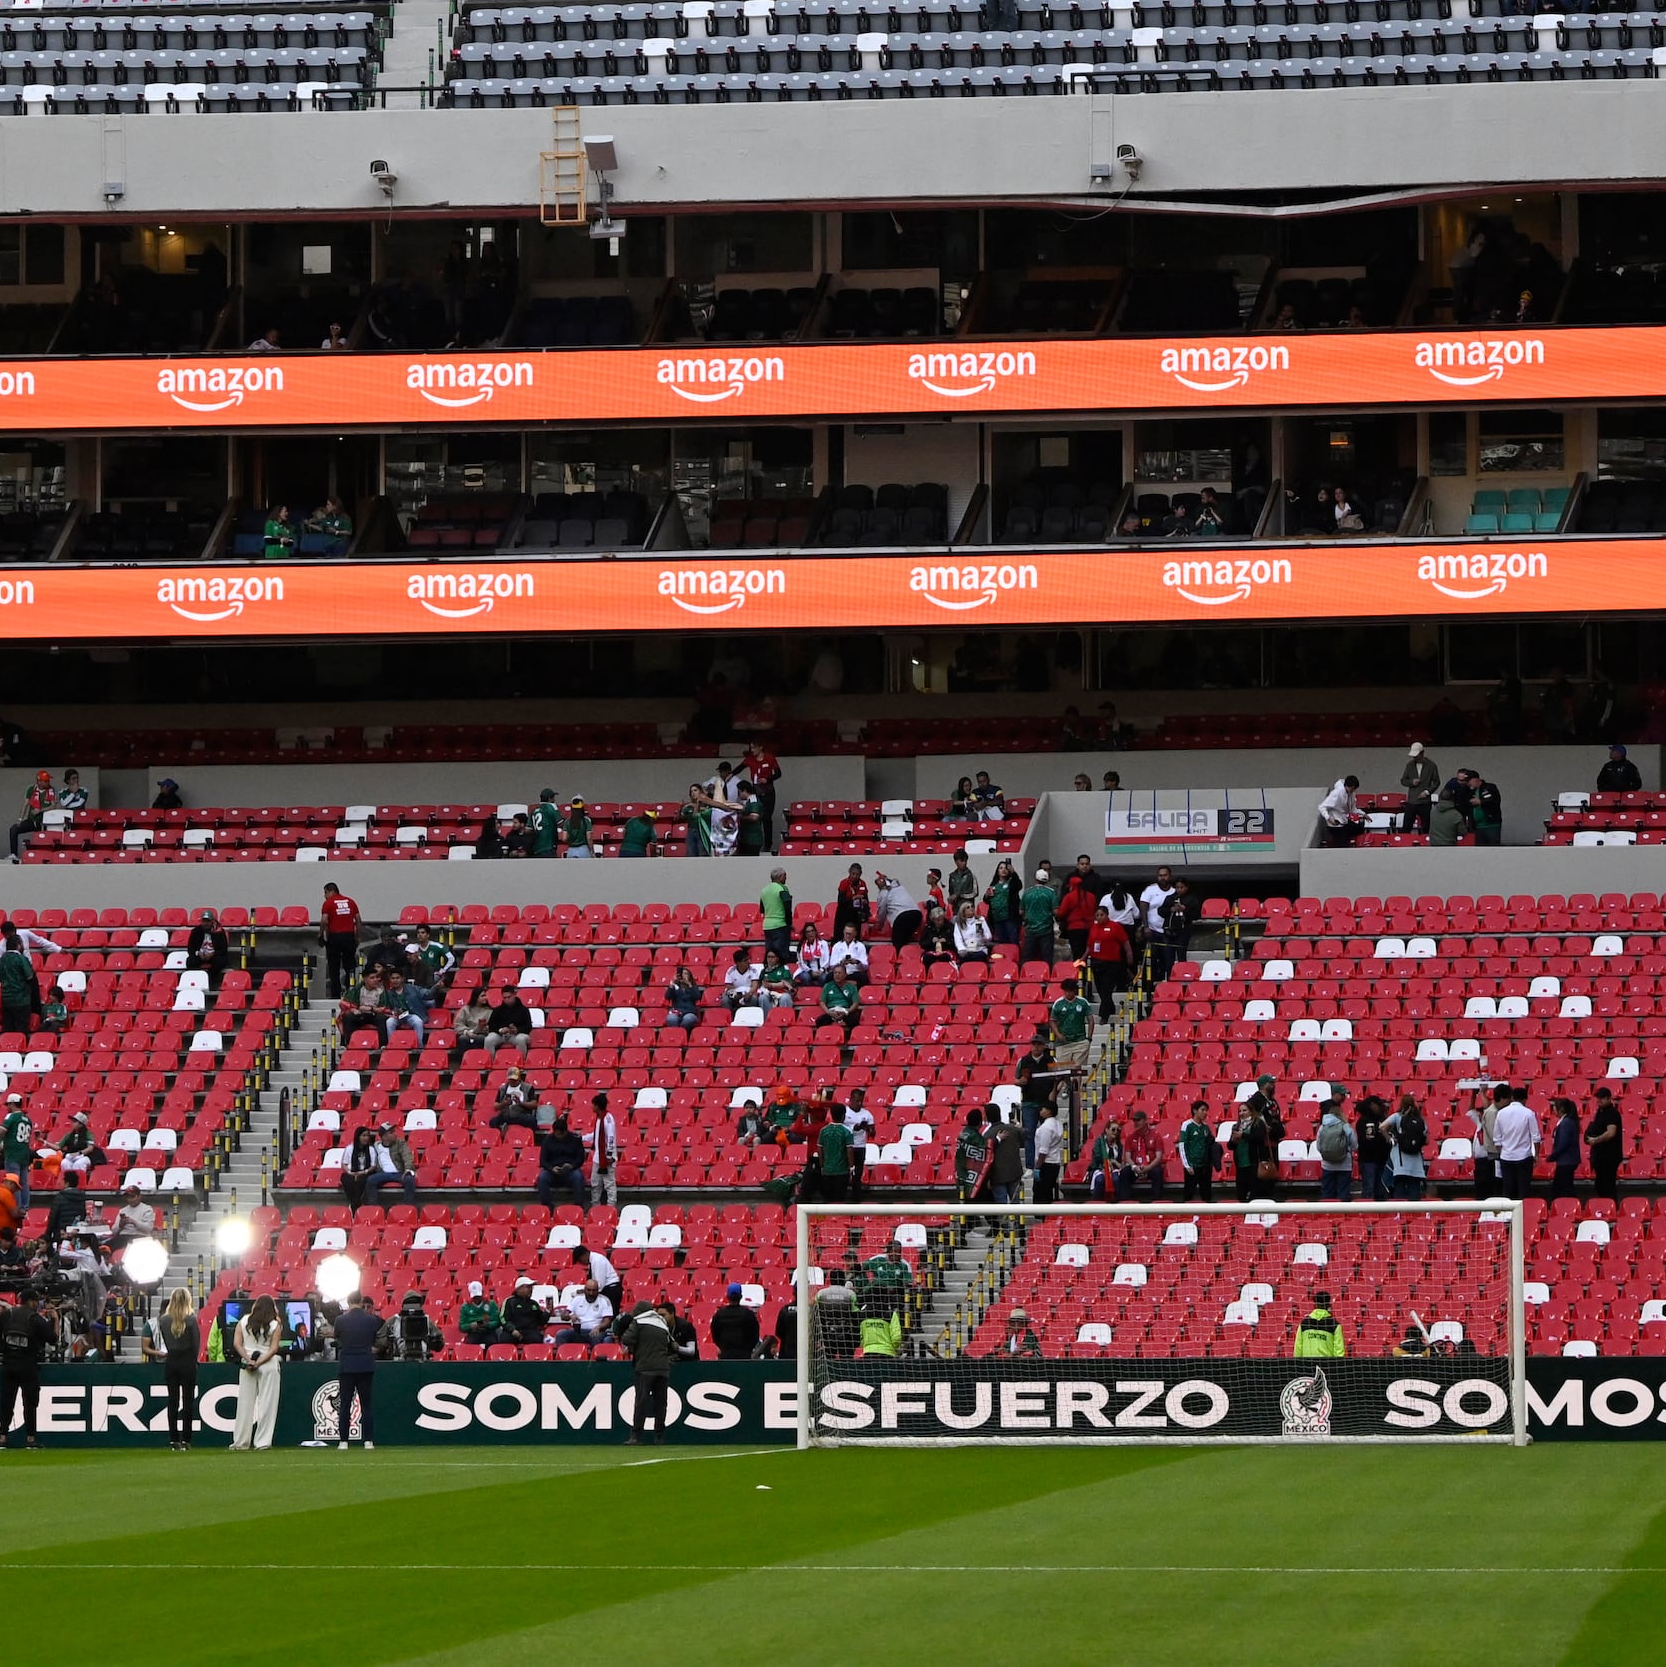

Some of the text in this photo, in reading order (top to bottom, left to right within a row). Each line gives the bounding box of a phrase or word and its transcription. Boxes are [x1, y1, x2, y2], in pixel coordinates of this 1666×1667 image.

[158, 367, 283, 392] amazon
[407, 363, 533, 388] amazon
[657, 358, 784, 383] amazon
[908, 352, 1035, 378] amazon
[1161, 346, 1289, 372] amazon
[1416, 340, 1544, 366] amazon
[158, 577, 283, 602] amazon
[408, 574, 534, 598] amazon
[658, 570, 785, 594] amazon
[910, 565, 1037, 591] amazon
[1163, 560, 1291, 586] amazon
[1418, 553, 1547, 579] amazon
[1126, 811, 1265, 834] SALIDA 22
[415, 1380, 1230, 1432] SOMOS ESFUERZO
[318, 1427, 358, 1436] MÉXO
[1286, 1423, 1328, 1433] MÉXICO
